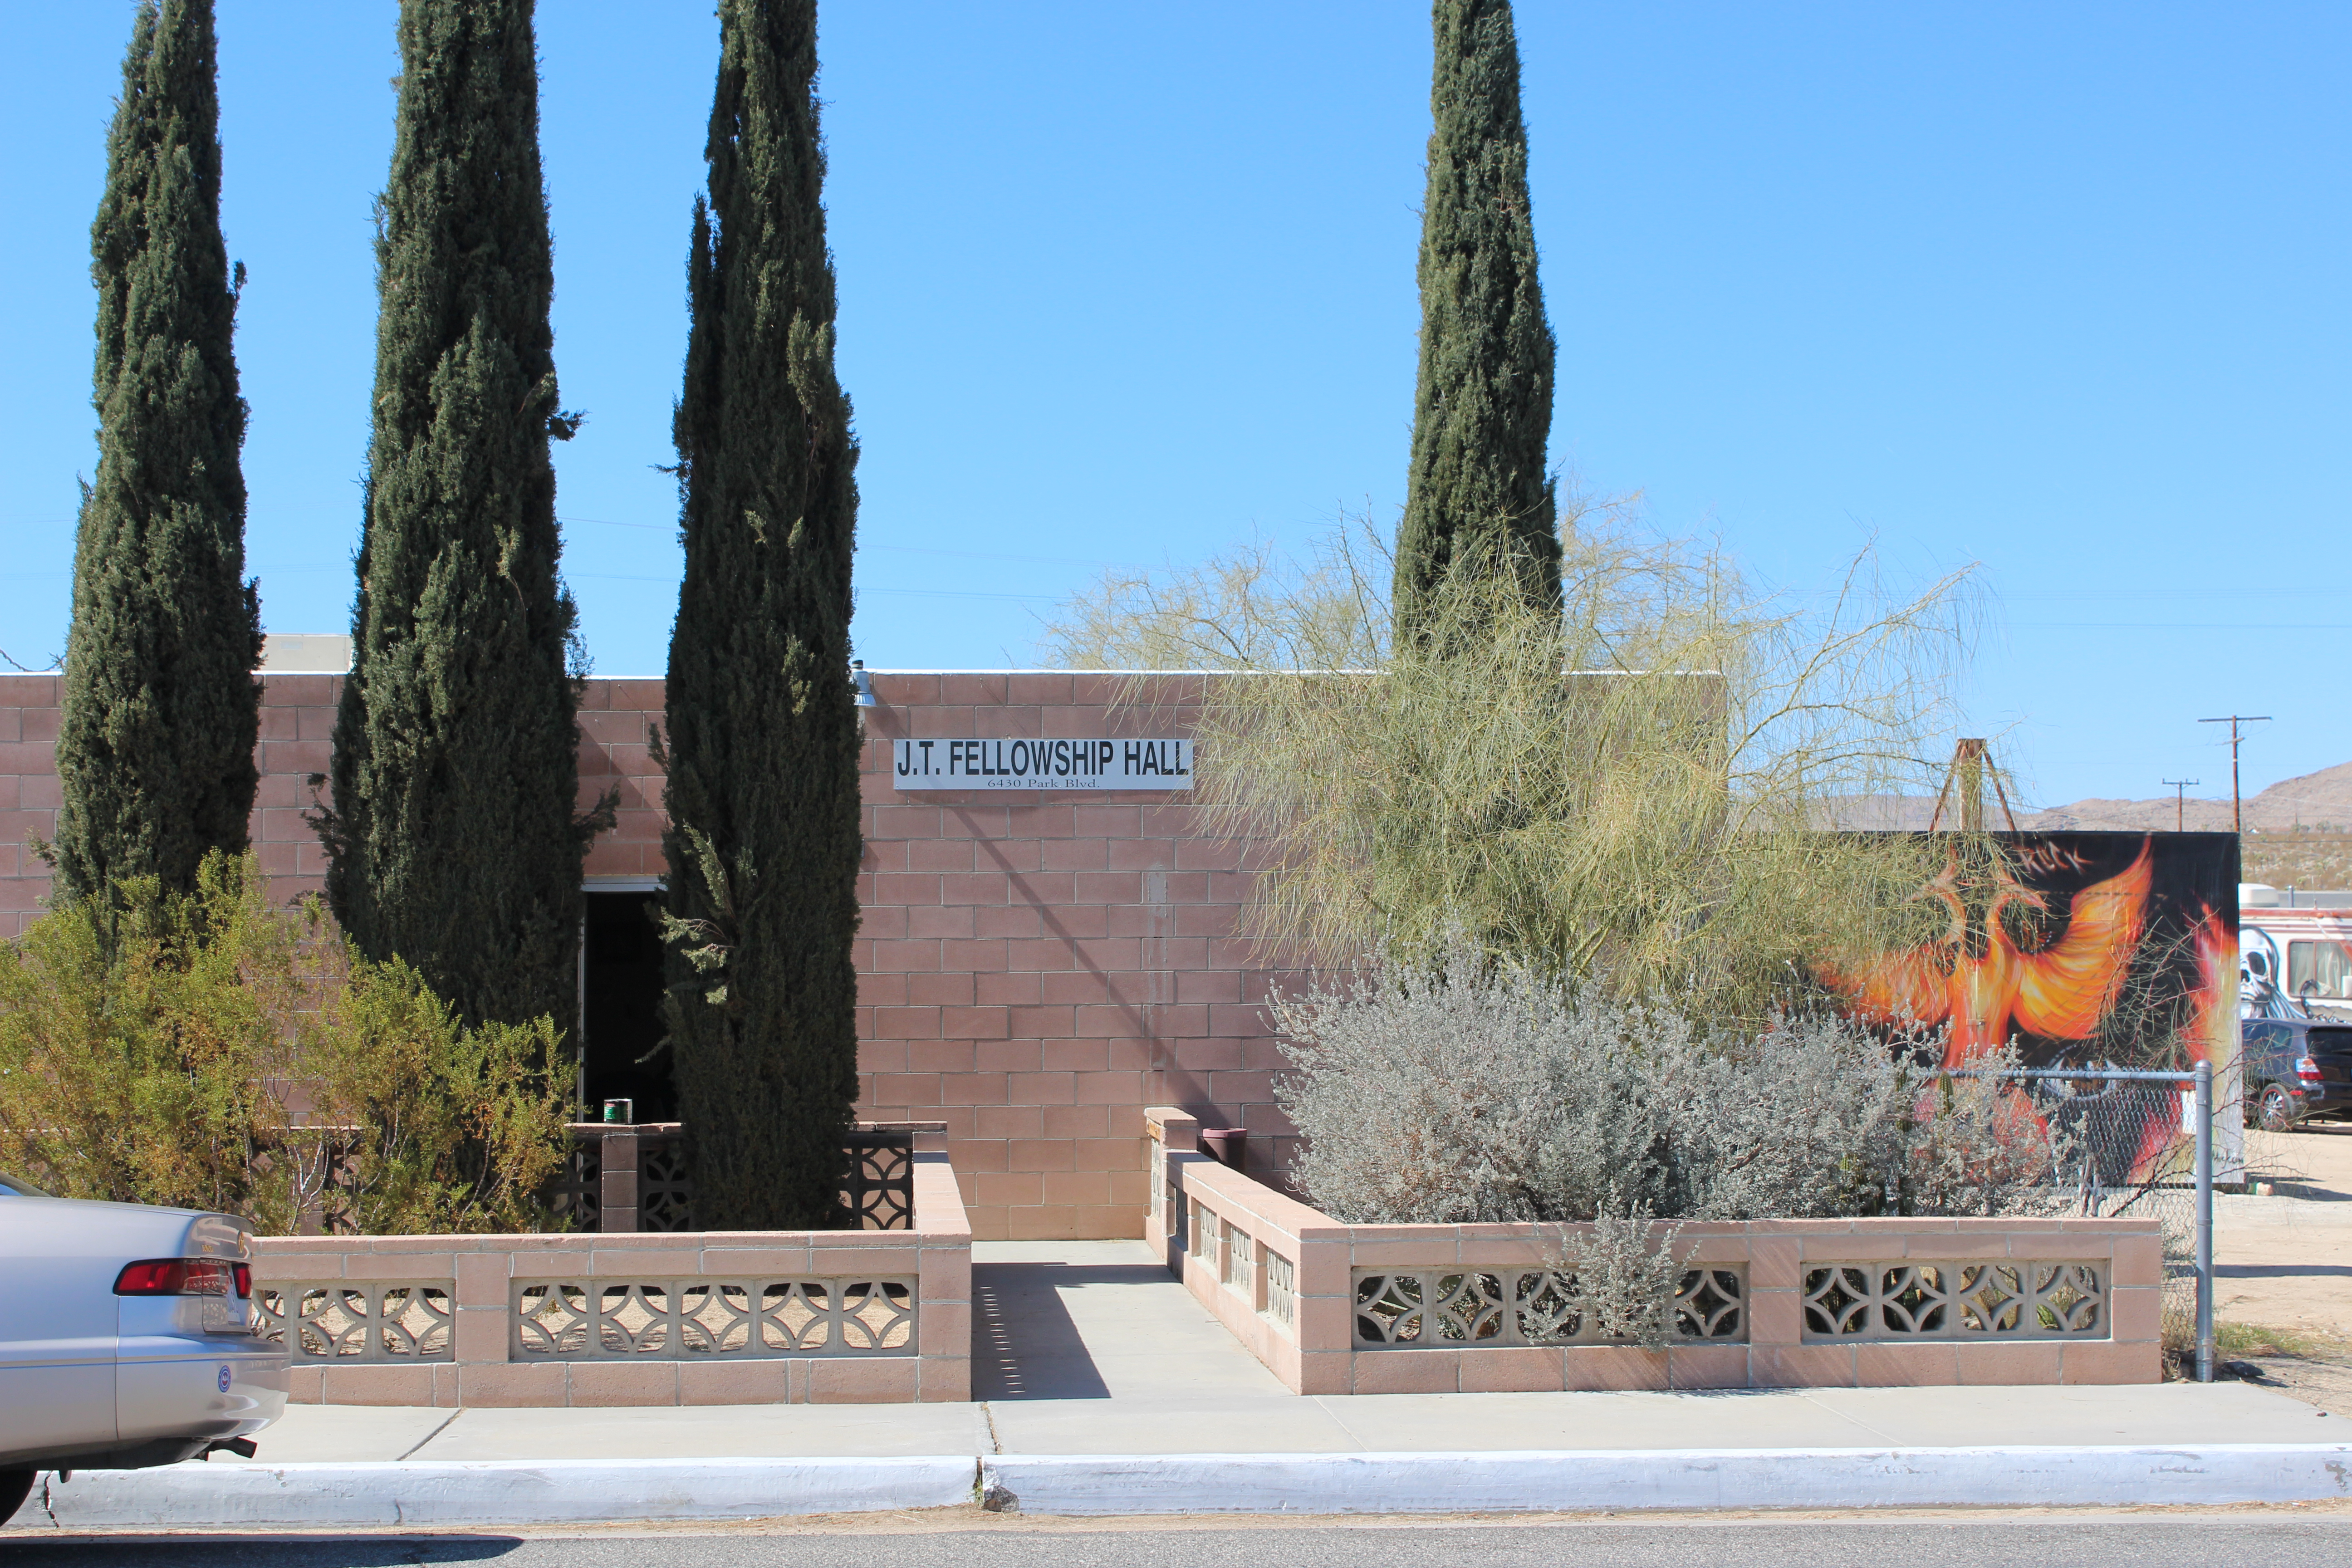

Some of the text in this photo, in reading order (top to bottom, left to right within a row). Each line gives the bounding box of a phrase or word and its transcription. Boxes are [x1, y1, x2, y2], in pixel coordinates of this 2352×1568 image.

[897, 740, 1189, 775] J.T. FELLOWSHIP HALL
[988, 779, 1100, 788] 6430 Park Blvd.
